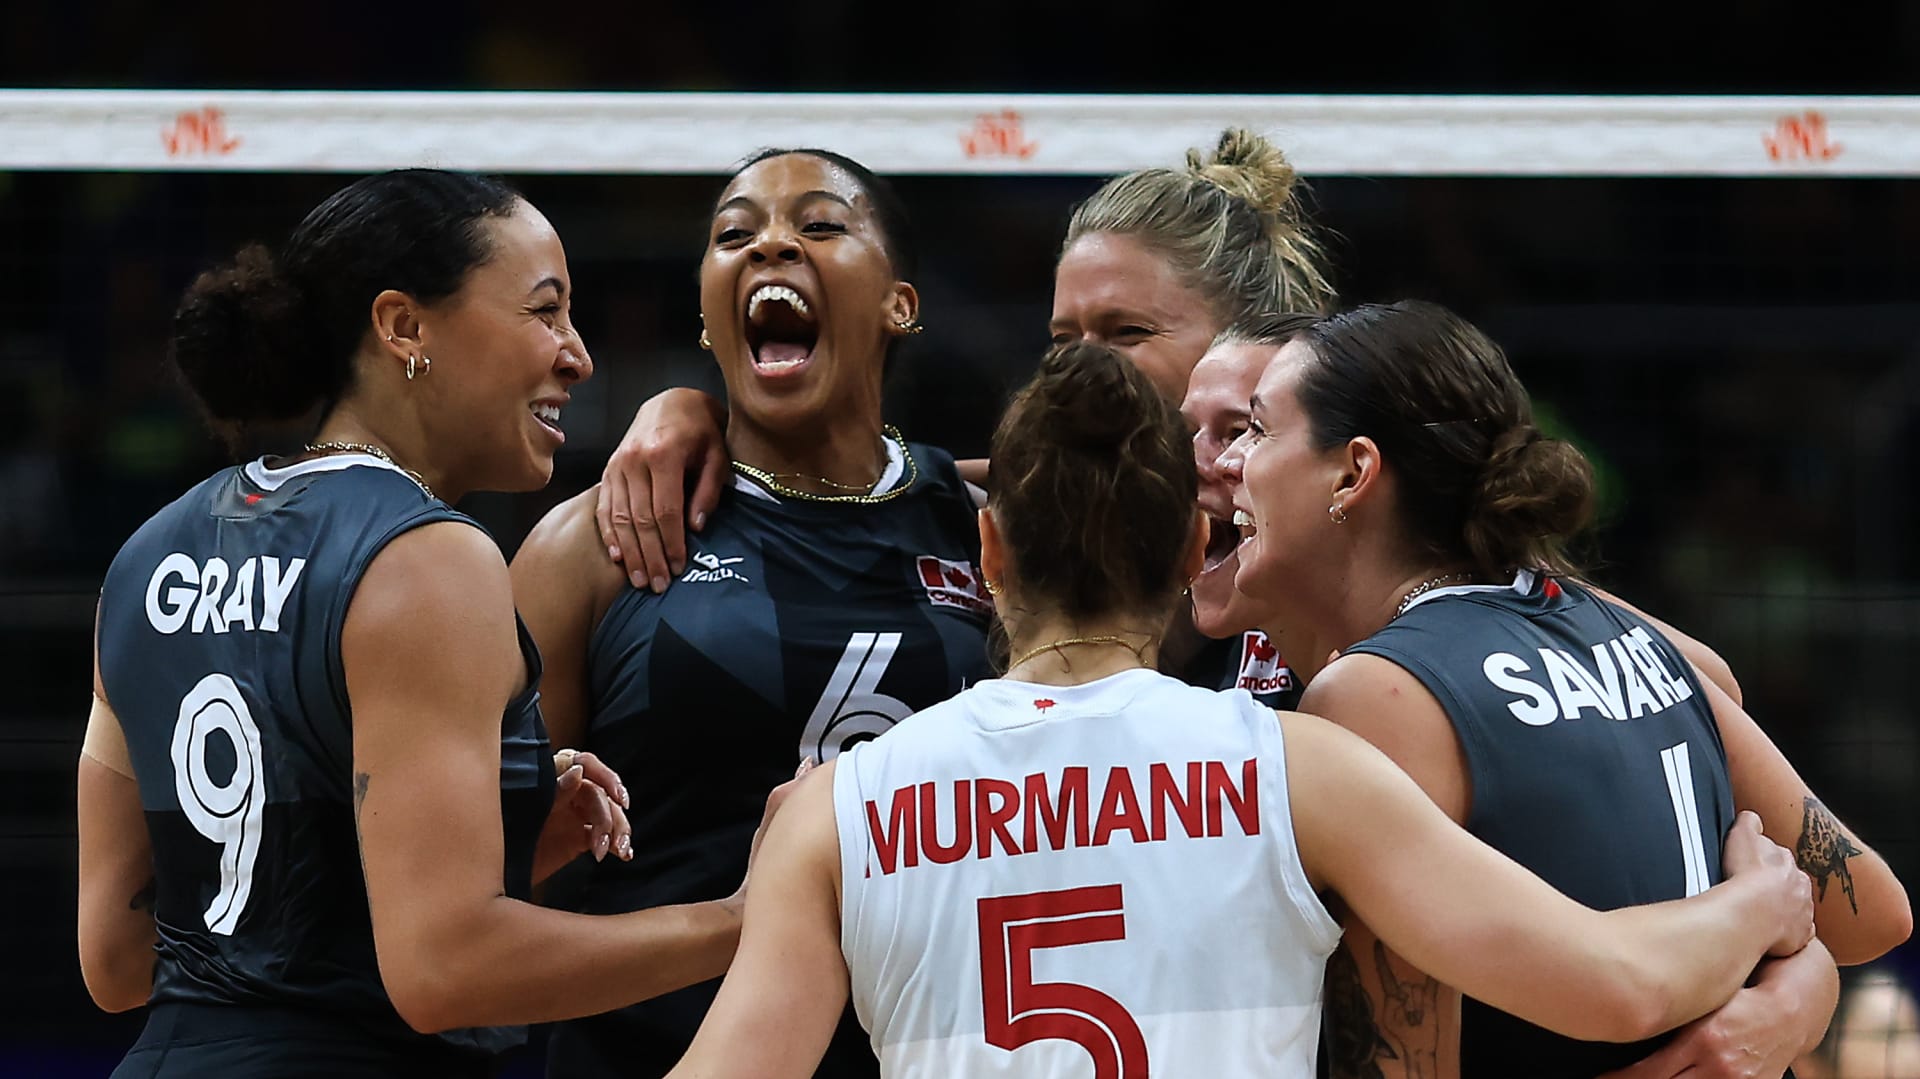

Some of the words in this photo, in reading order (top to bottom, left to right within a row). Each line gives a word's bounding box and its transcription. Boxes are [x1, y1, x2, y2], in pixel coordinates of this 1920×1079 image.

[146, 552, 306, 634] GRAY
[799, 632, 915, 765] 6
[1238, 673, 1290, 691] anada
[171, 673, 266, 936] 9
[865, 757, 1261, 878] MURMANN
[977, 883, 1149, 1079] 5
